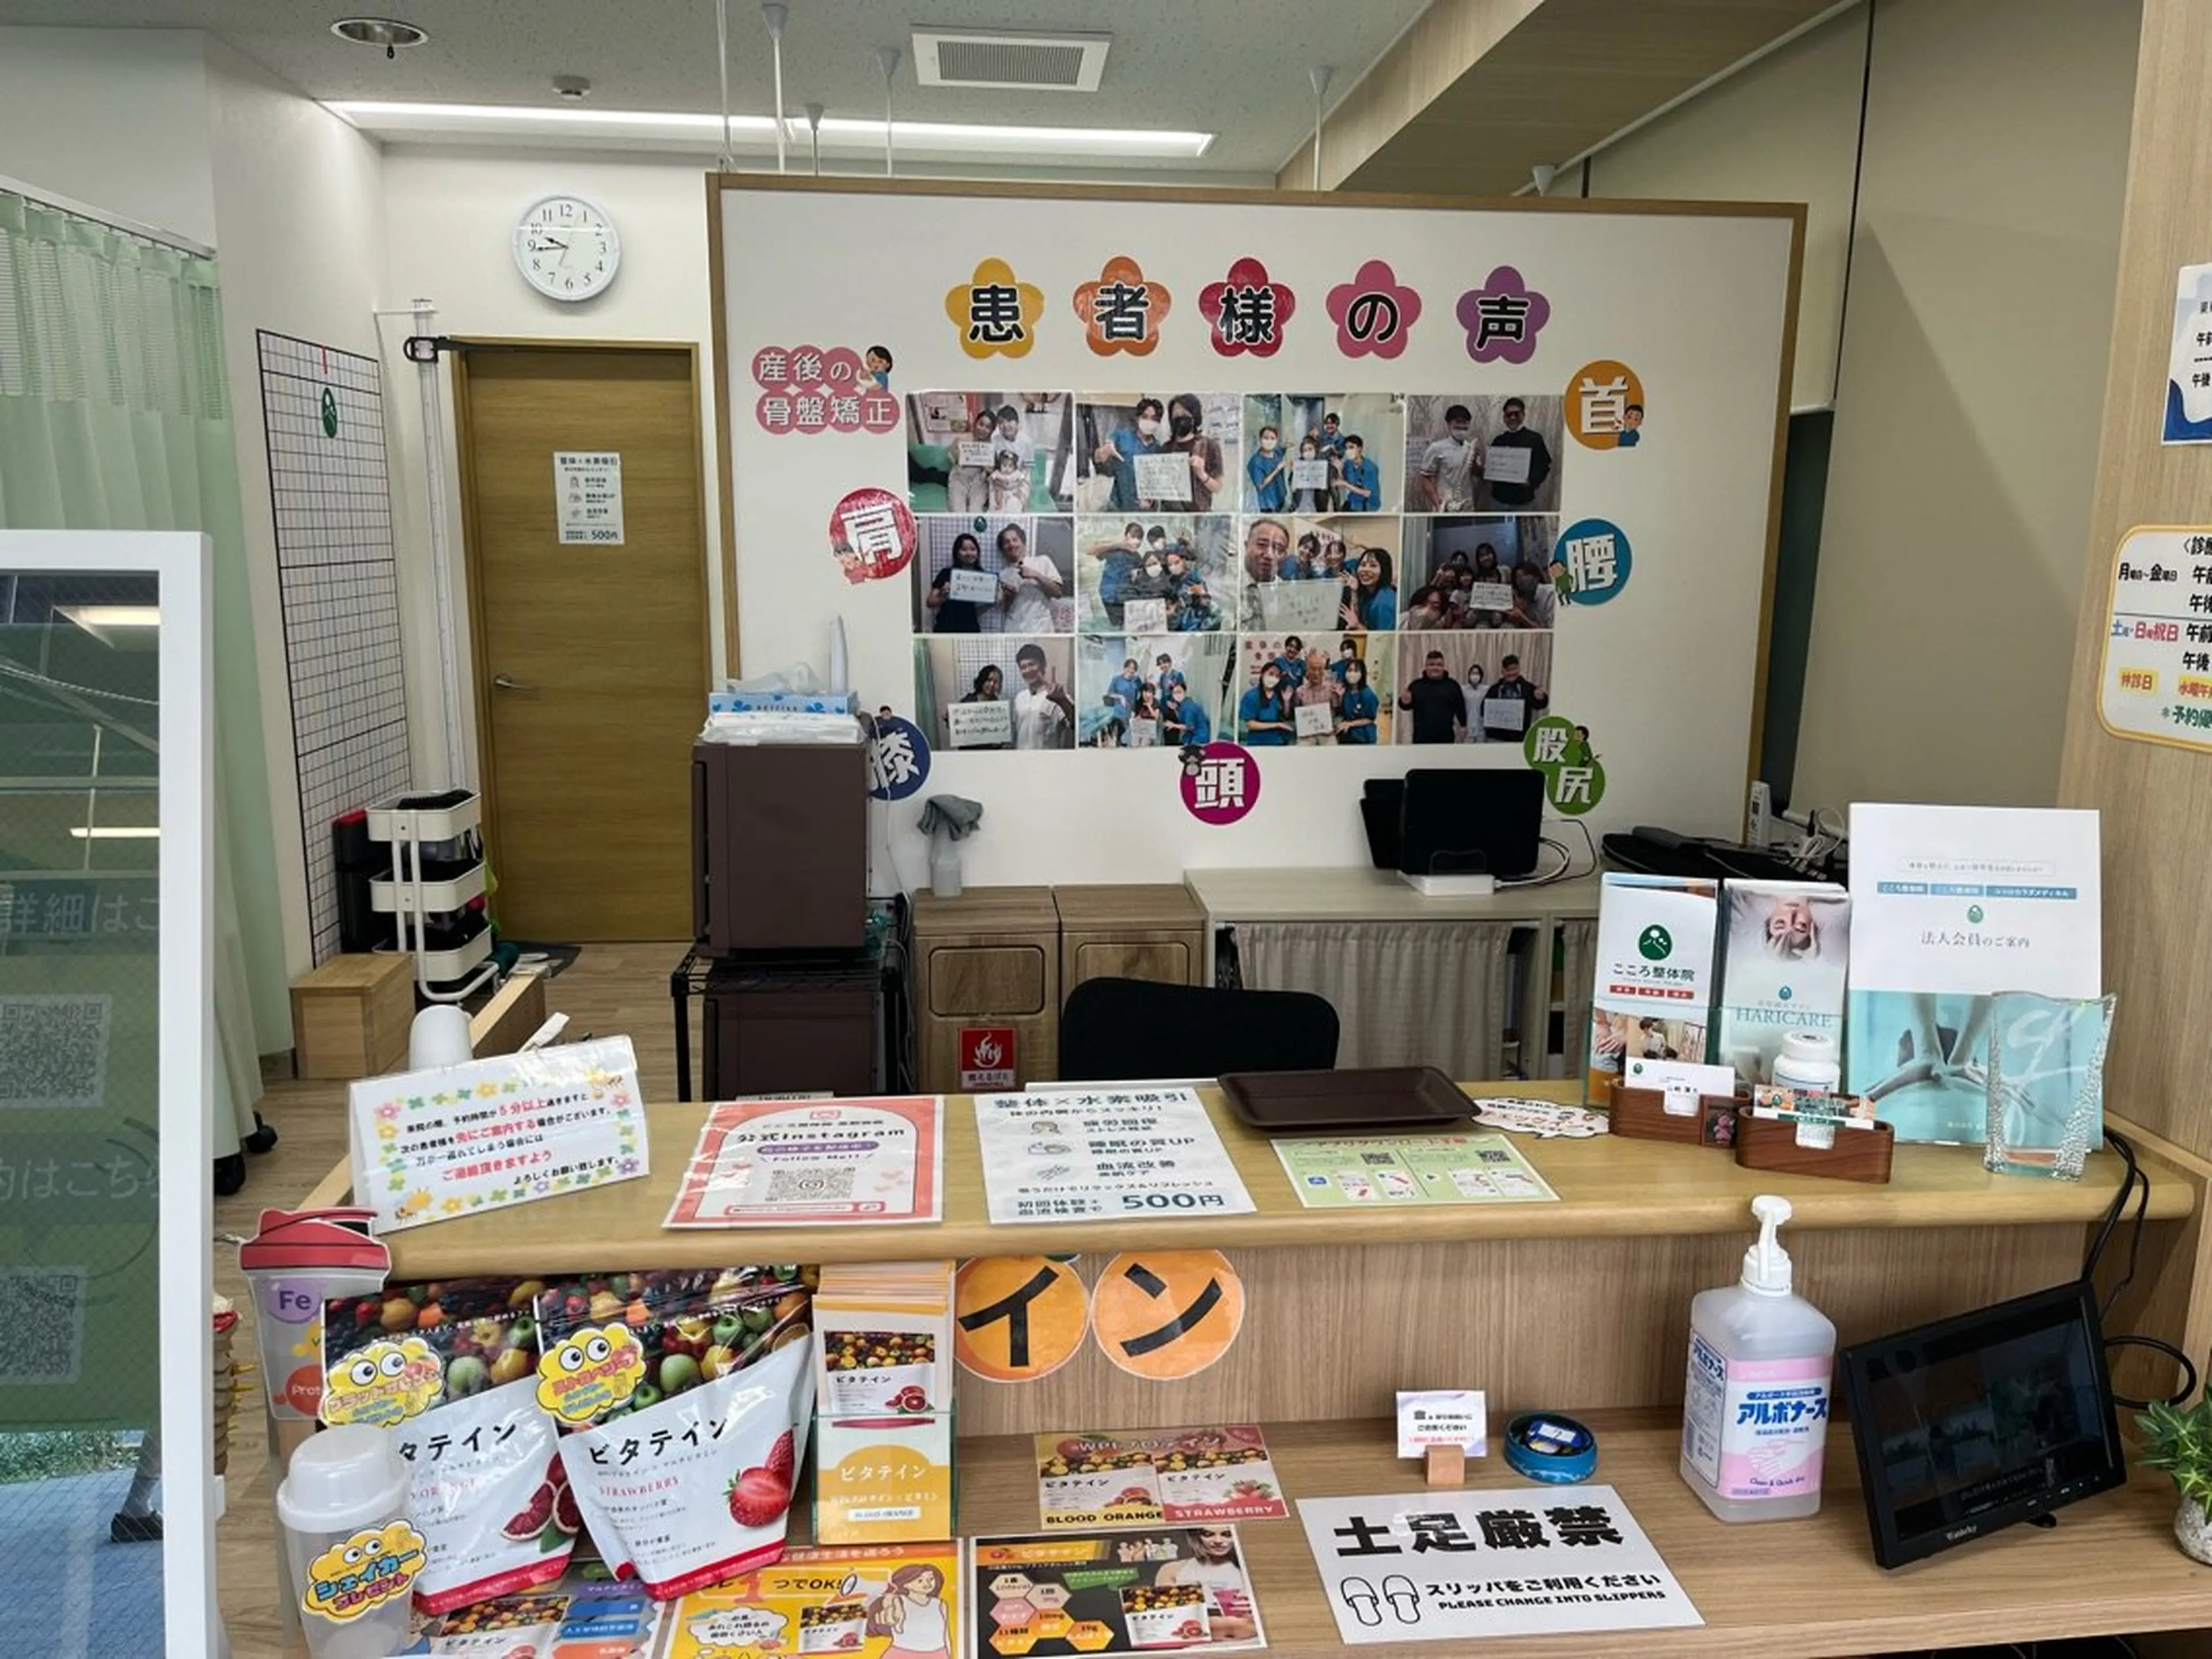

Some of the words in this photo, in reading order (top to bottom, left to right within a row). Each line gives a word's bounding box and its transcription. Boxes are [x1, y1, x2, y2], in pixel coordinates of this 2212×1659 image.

[543, 209, 552, 221] 11
[560, 204, 573, 217] 12
[531, 222, 543, 234] 10
[594, 223, 603, 236] 2
[528, 240, 536, 252] 9
[600, 241, 607, 254] 3
[533, 259, 541, 271] 8
[596, 260, 603, 272] 4
[548, 271, 555, 283] 7
[565, 278, 573, 289] 6
[584, 272, 591, 286] 5
[968, 285, 1531, 350] 患者様の声
[758, 352, 851, 382] 産後の
[763, 396, 893, 426] 骨盤矯正
[1579, 376, 1631, 435] 首
[841, 505, 902, 565] 肩
[1565, 533, 1617, 591] 腰
[2182, 651, 2210, 672] 午後
[1532, 728, 1567, 763] 股
[1194, 758, 1246, 808] 頭
[1555, 765, 1593, 805] 尻
[1921, 930, 2031, 949] 法人会員のご案内
[1613, 963, 1695, 982] こころ整体院
[1122, 1193, 1225, 1210] 500円
[280, 1290, 312, 1310] Fe
[836, 1375, 891, 1384] ビタテイン
[1736, 1397, 1827, 1425] アルボナース
[589, 1418, 728, 1466] ビタテイン
[841, 1464, 926, 1482] ビタテイン
[1167, 1472, 1226, 1483] ビタテイン
[1044, 1478, 1111, 1489] ビタテイン
[1047, 1514, 1097, 1525] BLOOD
[1103, 1510, 1163, 1522] ORANGE
[1173, 1505, 1274, 1519] STRAWBERRY
[1334, 1504, 1624, 1558] 土足厳禁
[315, 1548, 419, 1602] シェイカー
[1426, 1574, 1661, 1598] スリッパをご利用ください
[1438, 1599, 1494, 1611] PLEASE
[1497, 1596, 1554, 1608] CHANGE
[1555, 1593, 1593, 1604] INTO
[1594, 1590, 1666, 1603] SLIPPERS
[445, 1635, 507, 1647] ビタテイン
